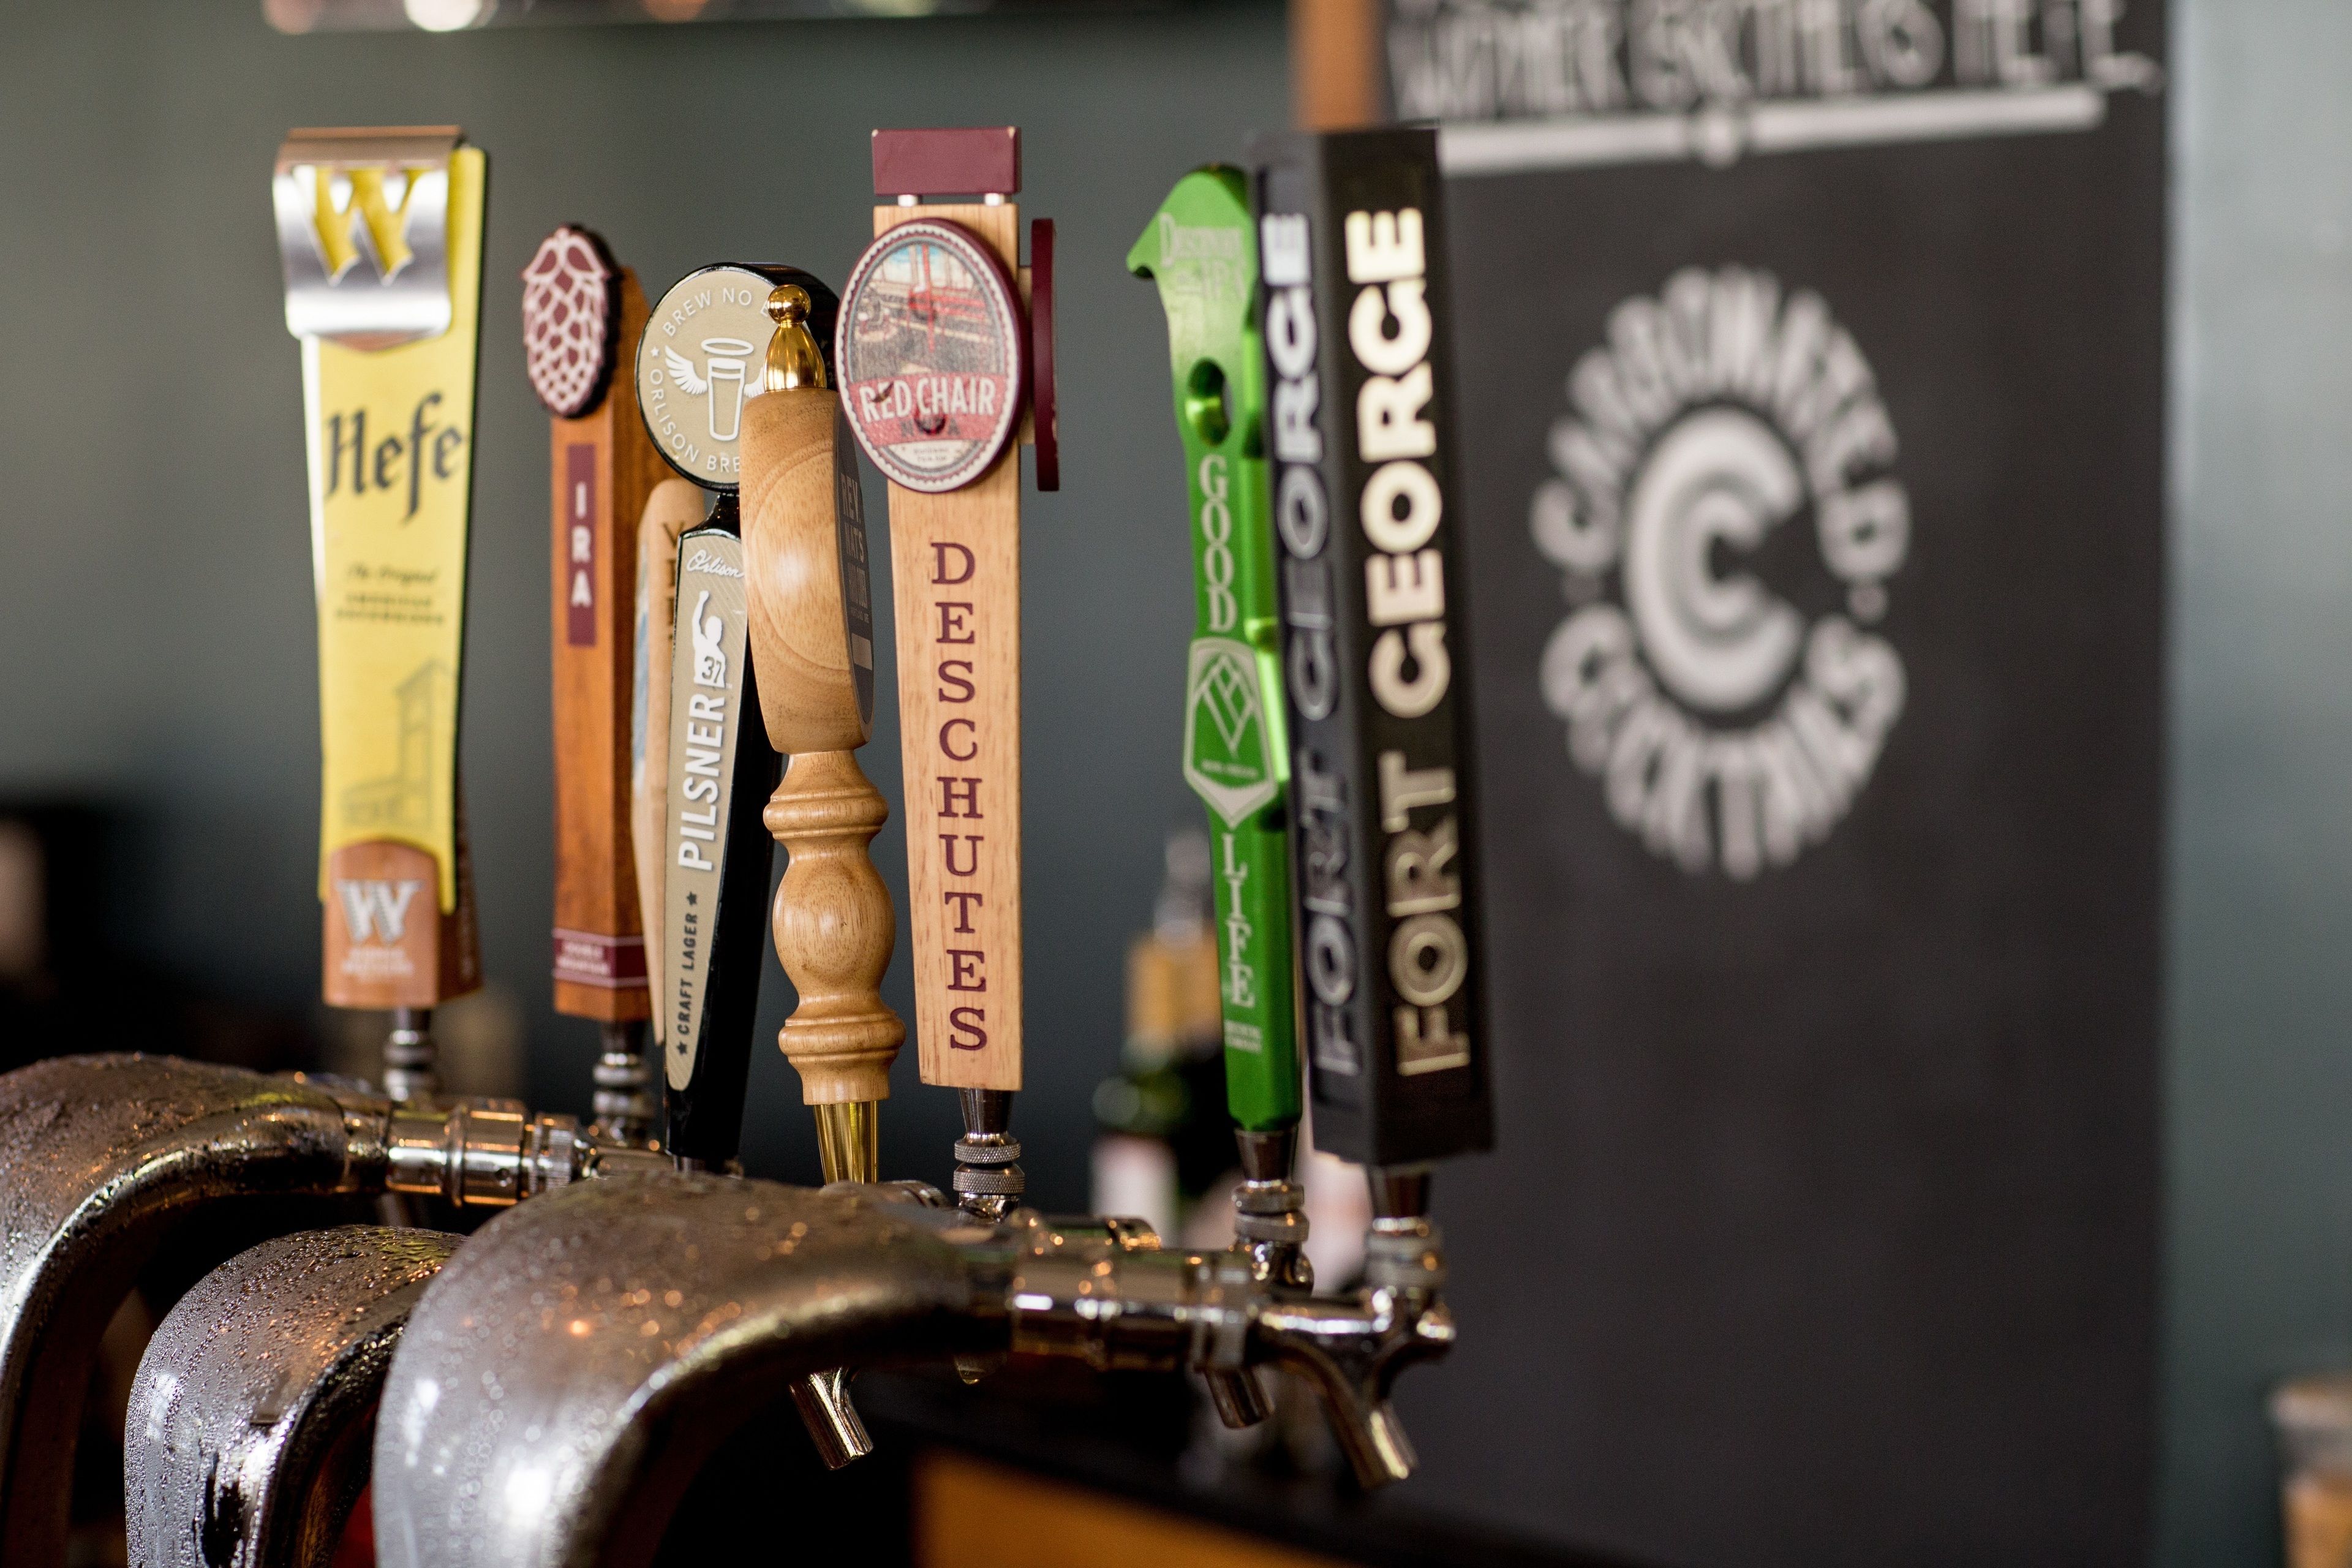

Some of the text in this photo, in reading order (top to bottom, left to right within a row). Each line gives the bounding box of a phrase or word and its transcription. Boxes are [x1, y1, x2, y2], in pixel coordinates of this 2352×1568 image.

[662, 287, 752, 337] BREW NO
[323, 390, 464, 528] Hefe
[650, 368, 699, 463] ORLISON
[859, 376, 997, 424] RED CHAIR
[571, 481, 593, 608] IRA
[1198, 453, 1238, 633] GOOD
[701, 655, 723, 684] 37
[1344, 207, 1471, 1077] FORT GEORGE
[677, 693, 726, 871] PILSNER
[930, 542, 989, 1052] DESCHUTES
[336, 878, 423, 943] W
[1222, 832, 1256, 1009] LIFE
[677, 913, 698, 1036] CRAFT LAGER
